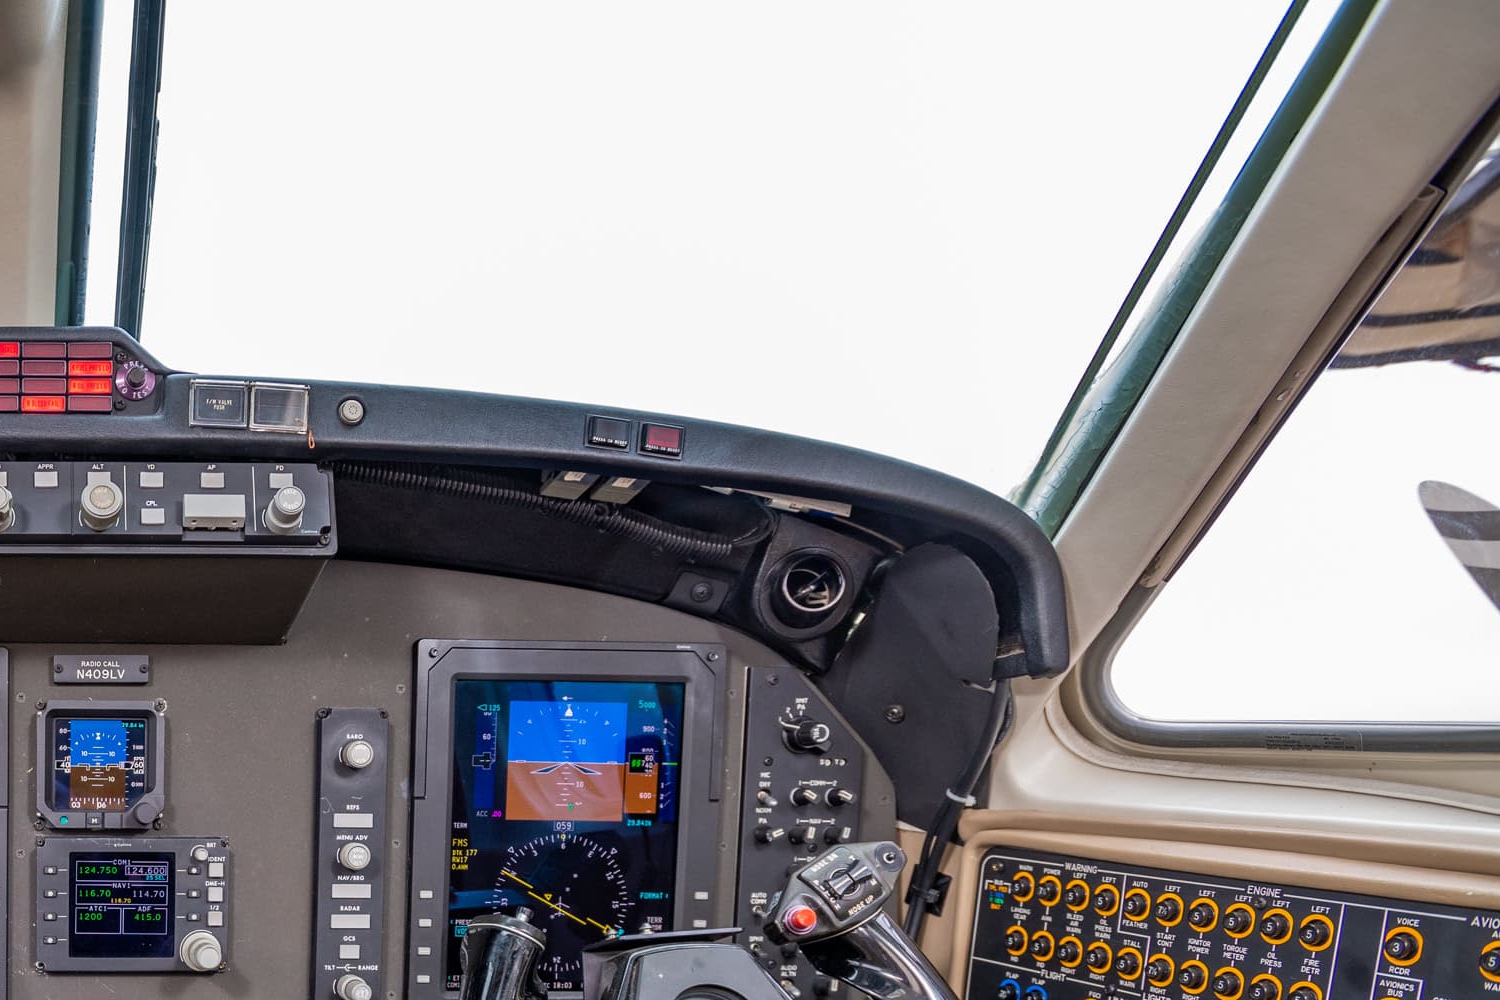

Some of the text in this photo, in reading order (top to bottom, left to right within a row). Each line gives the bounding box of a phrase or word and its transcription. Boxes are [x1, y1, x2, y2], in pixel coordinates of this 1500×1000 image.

[77, 669, 125, 680] N409LV
[556, 822, 572, 830] 059
[1065, 862, 1098, 874] WARNING
[133, 890, 165, 898] 114.70
[1165, 885, 1181, 893] LEFT
[1247, 886, 1281, 897] ENGINE
[1122, 920, 1148, 930] FEATHER
[1397, 917, 1420, 927] VOICE
[1156, 932, 1176, 942] START
[1388, 967, 1410, 976] RCDR
